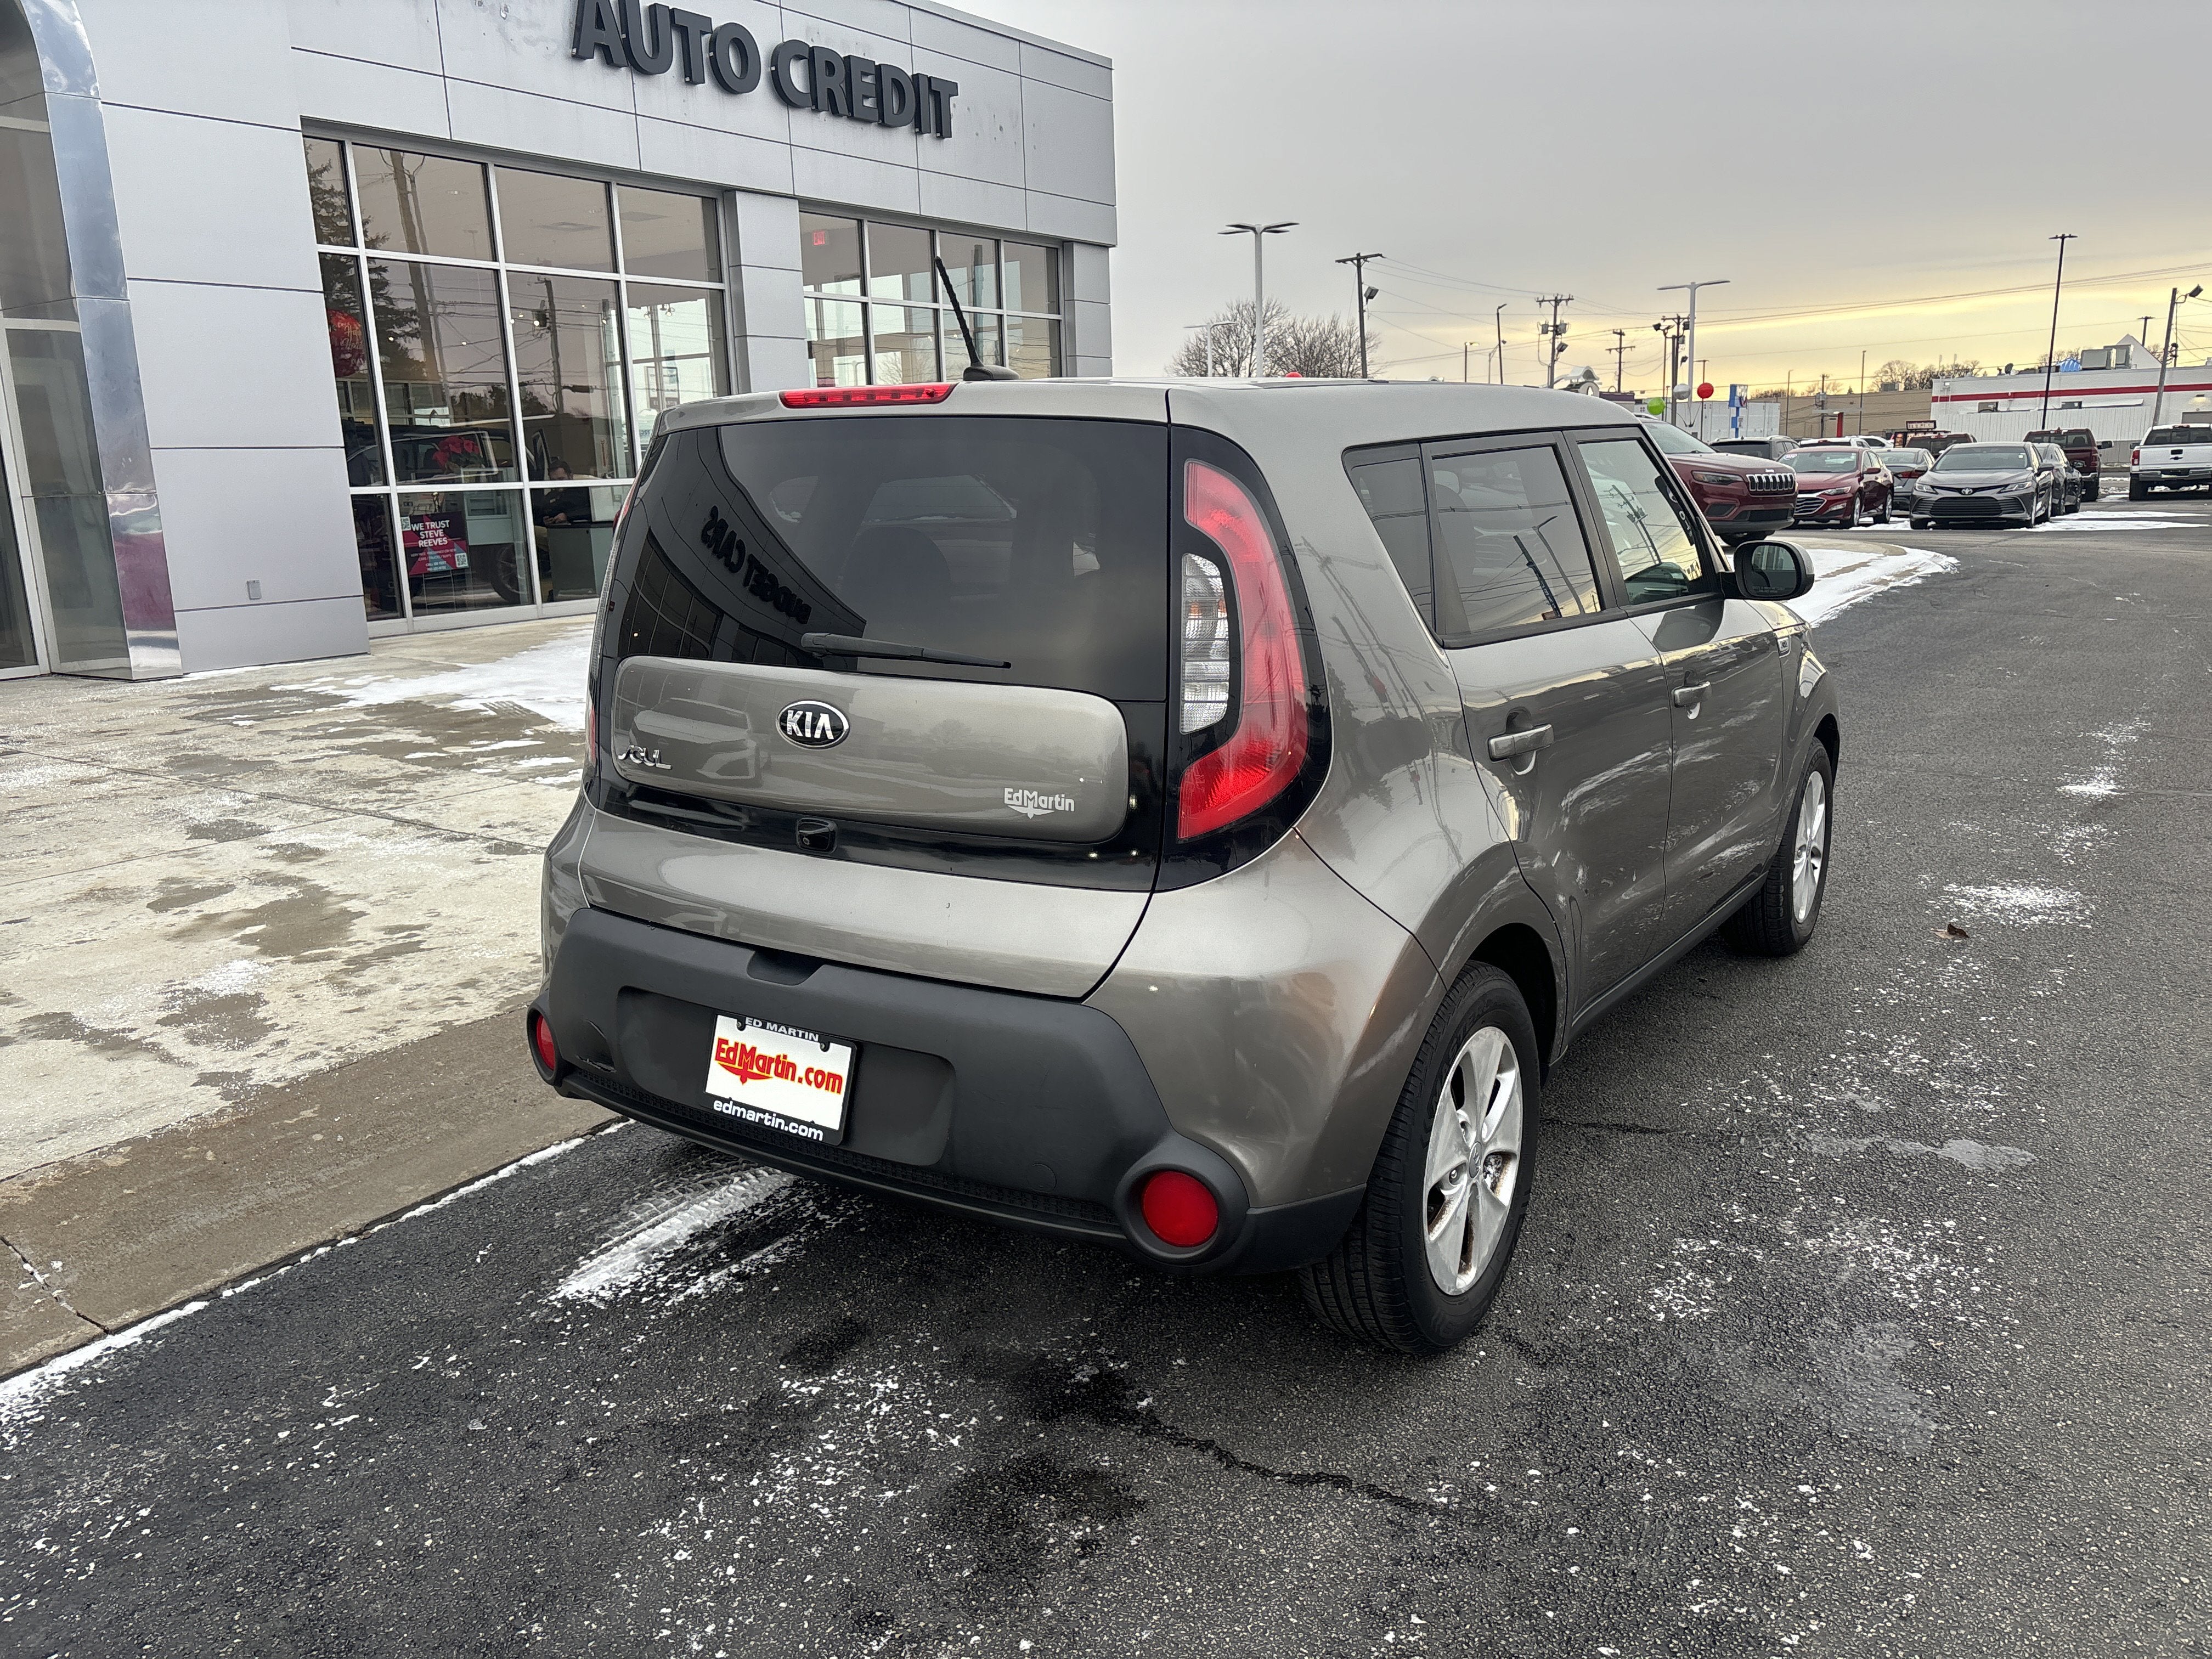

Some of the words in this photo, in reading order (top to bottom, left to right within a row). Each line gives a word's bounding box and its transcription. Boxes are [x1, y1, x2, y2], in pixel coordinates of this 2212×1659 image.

[572, 0, 761, 94] AUTO
[771, 39, 958, 138] CREDIT
[411, 522, 425, 531] WE
[425, 520, 450, 529] TRUST
[420, 529, 445, 539] STEVE
[418, 537, 448, 548] REEVES
[786, 710, 834, 740] KIA
[1004, 787, 1075, 812] EdMartin
[745, 1017, 763, 1028] ED
[766, 1022, 819, 1042] MARTIN
[715, 1037, 843, 1094] EdMartin.com
[713, 1099, 823, 1141] edmartin.com
